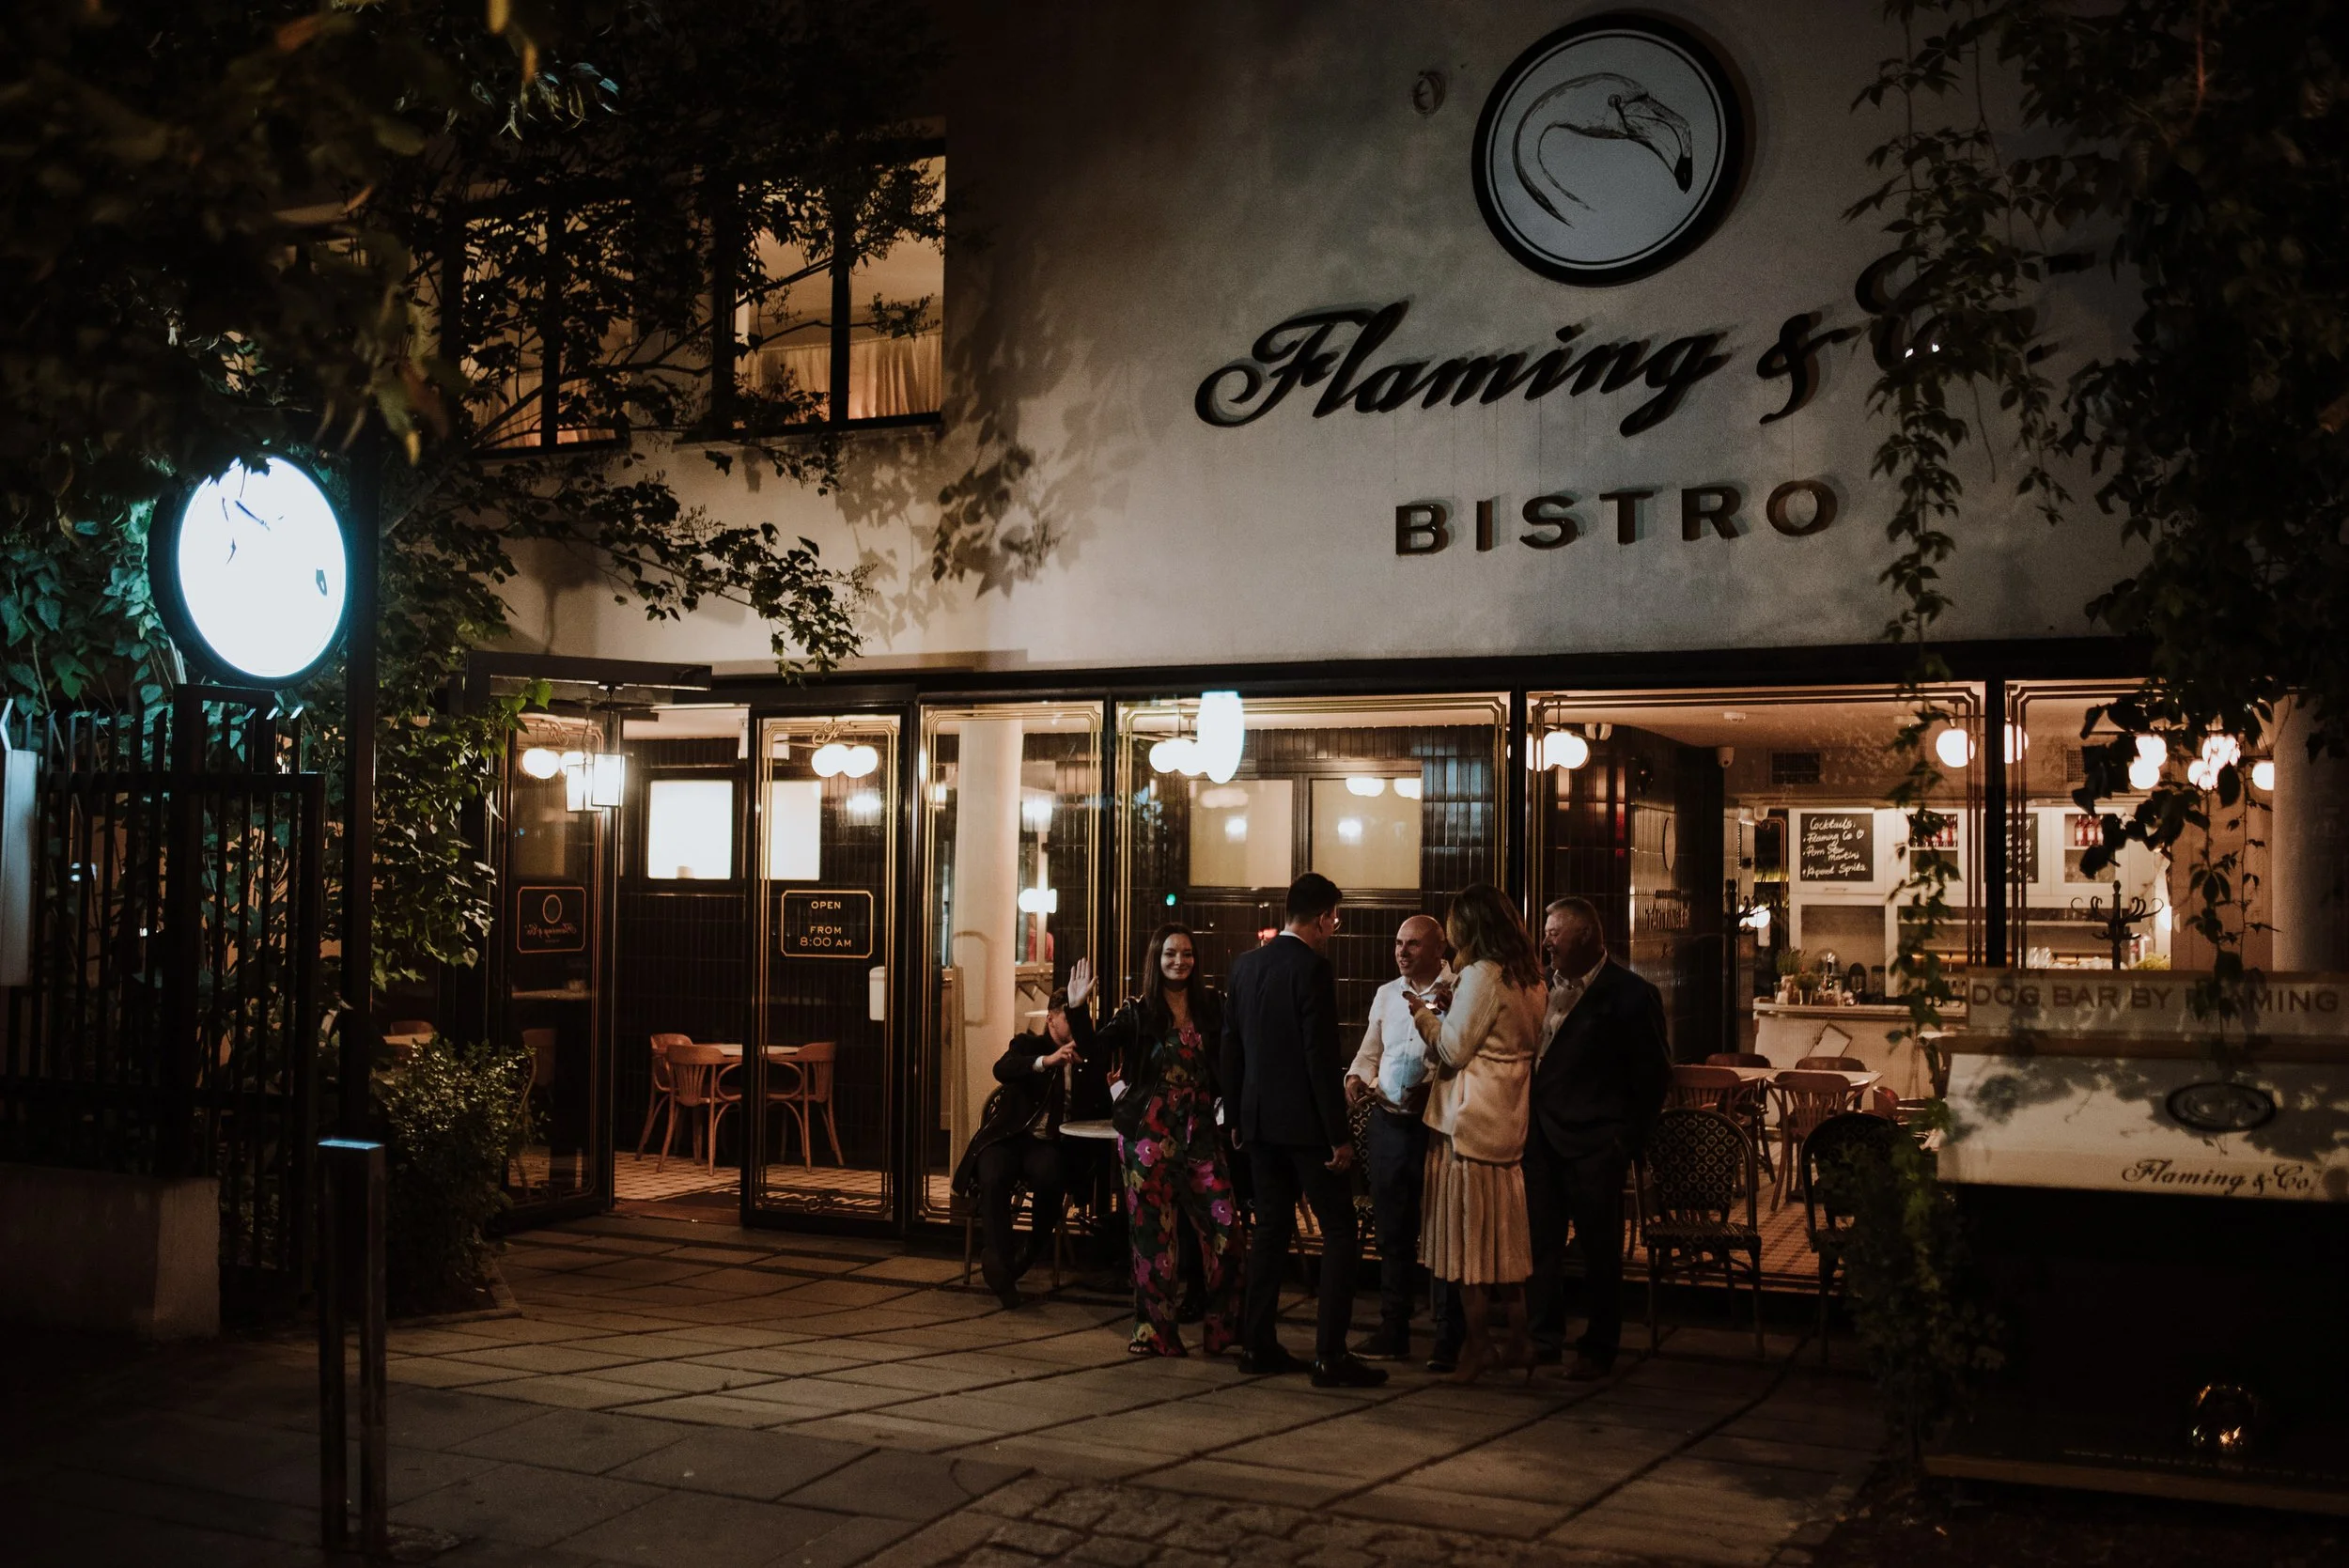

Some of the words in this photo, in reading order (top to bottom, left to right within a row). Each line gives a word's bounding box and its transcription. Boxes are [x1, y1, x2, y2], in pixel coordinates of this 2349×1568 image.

[1194, 300, 1737, 437] Flaming
[1756, 313, 1859, 425] &
[1395, 479, 1838, 556] BISTRO
[811, 900, 842, 909] OPEN
[800, 936, 832, 947] 8:00
[835, 939, 852, 947] AM
[810, 925, 842, 935] FROM
[1972, 985, 2040, 1007] DOG
[2053, 986, 2118, 1008] BAR
[2131, 987, 2173, 1009] BY
[2122, 1159, 2248, 1196] Flaming
[2252, 1173, 2273, 1194] &
